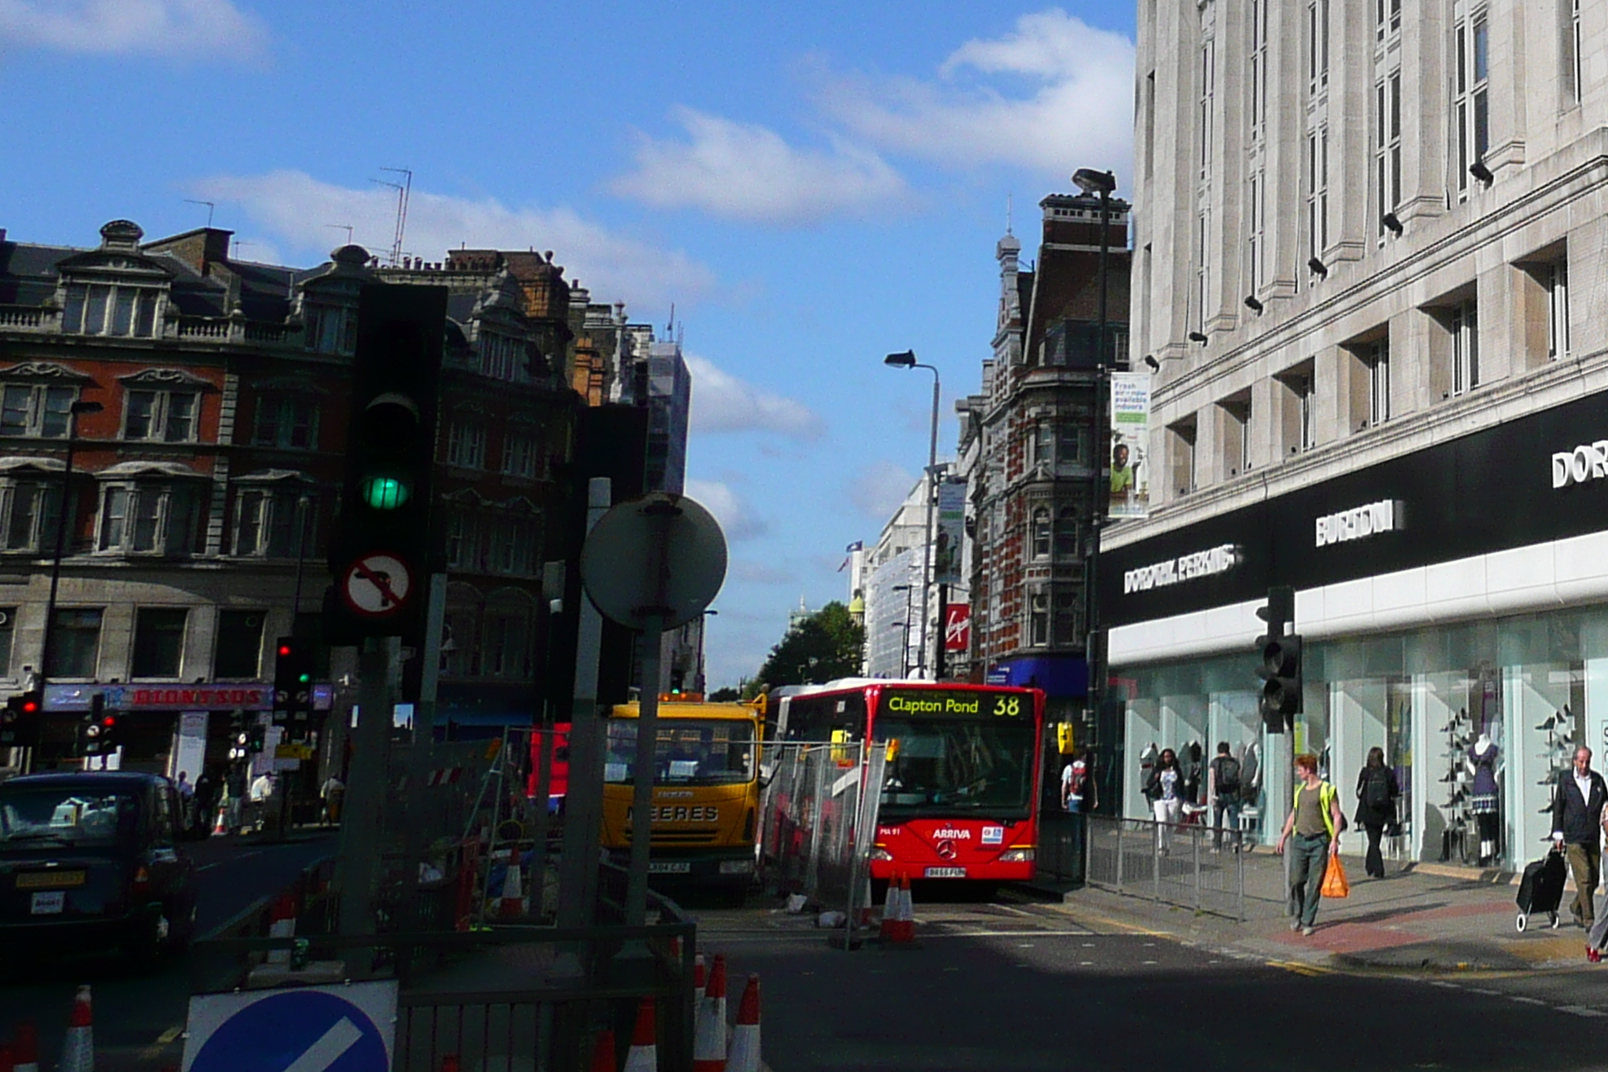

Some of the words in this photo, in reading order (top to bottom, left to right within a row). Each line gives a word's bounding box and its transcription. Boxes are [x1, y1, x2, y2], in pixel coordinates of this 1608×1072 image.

[888, 697, 942, 715] Clapton
[945, 698, 979, 714] Pond
[993, 695, 1020, 716] 38
[932, 829, 971, 839] ARRIVA
